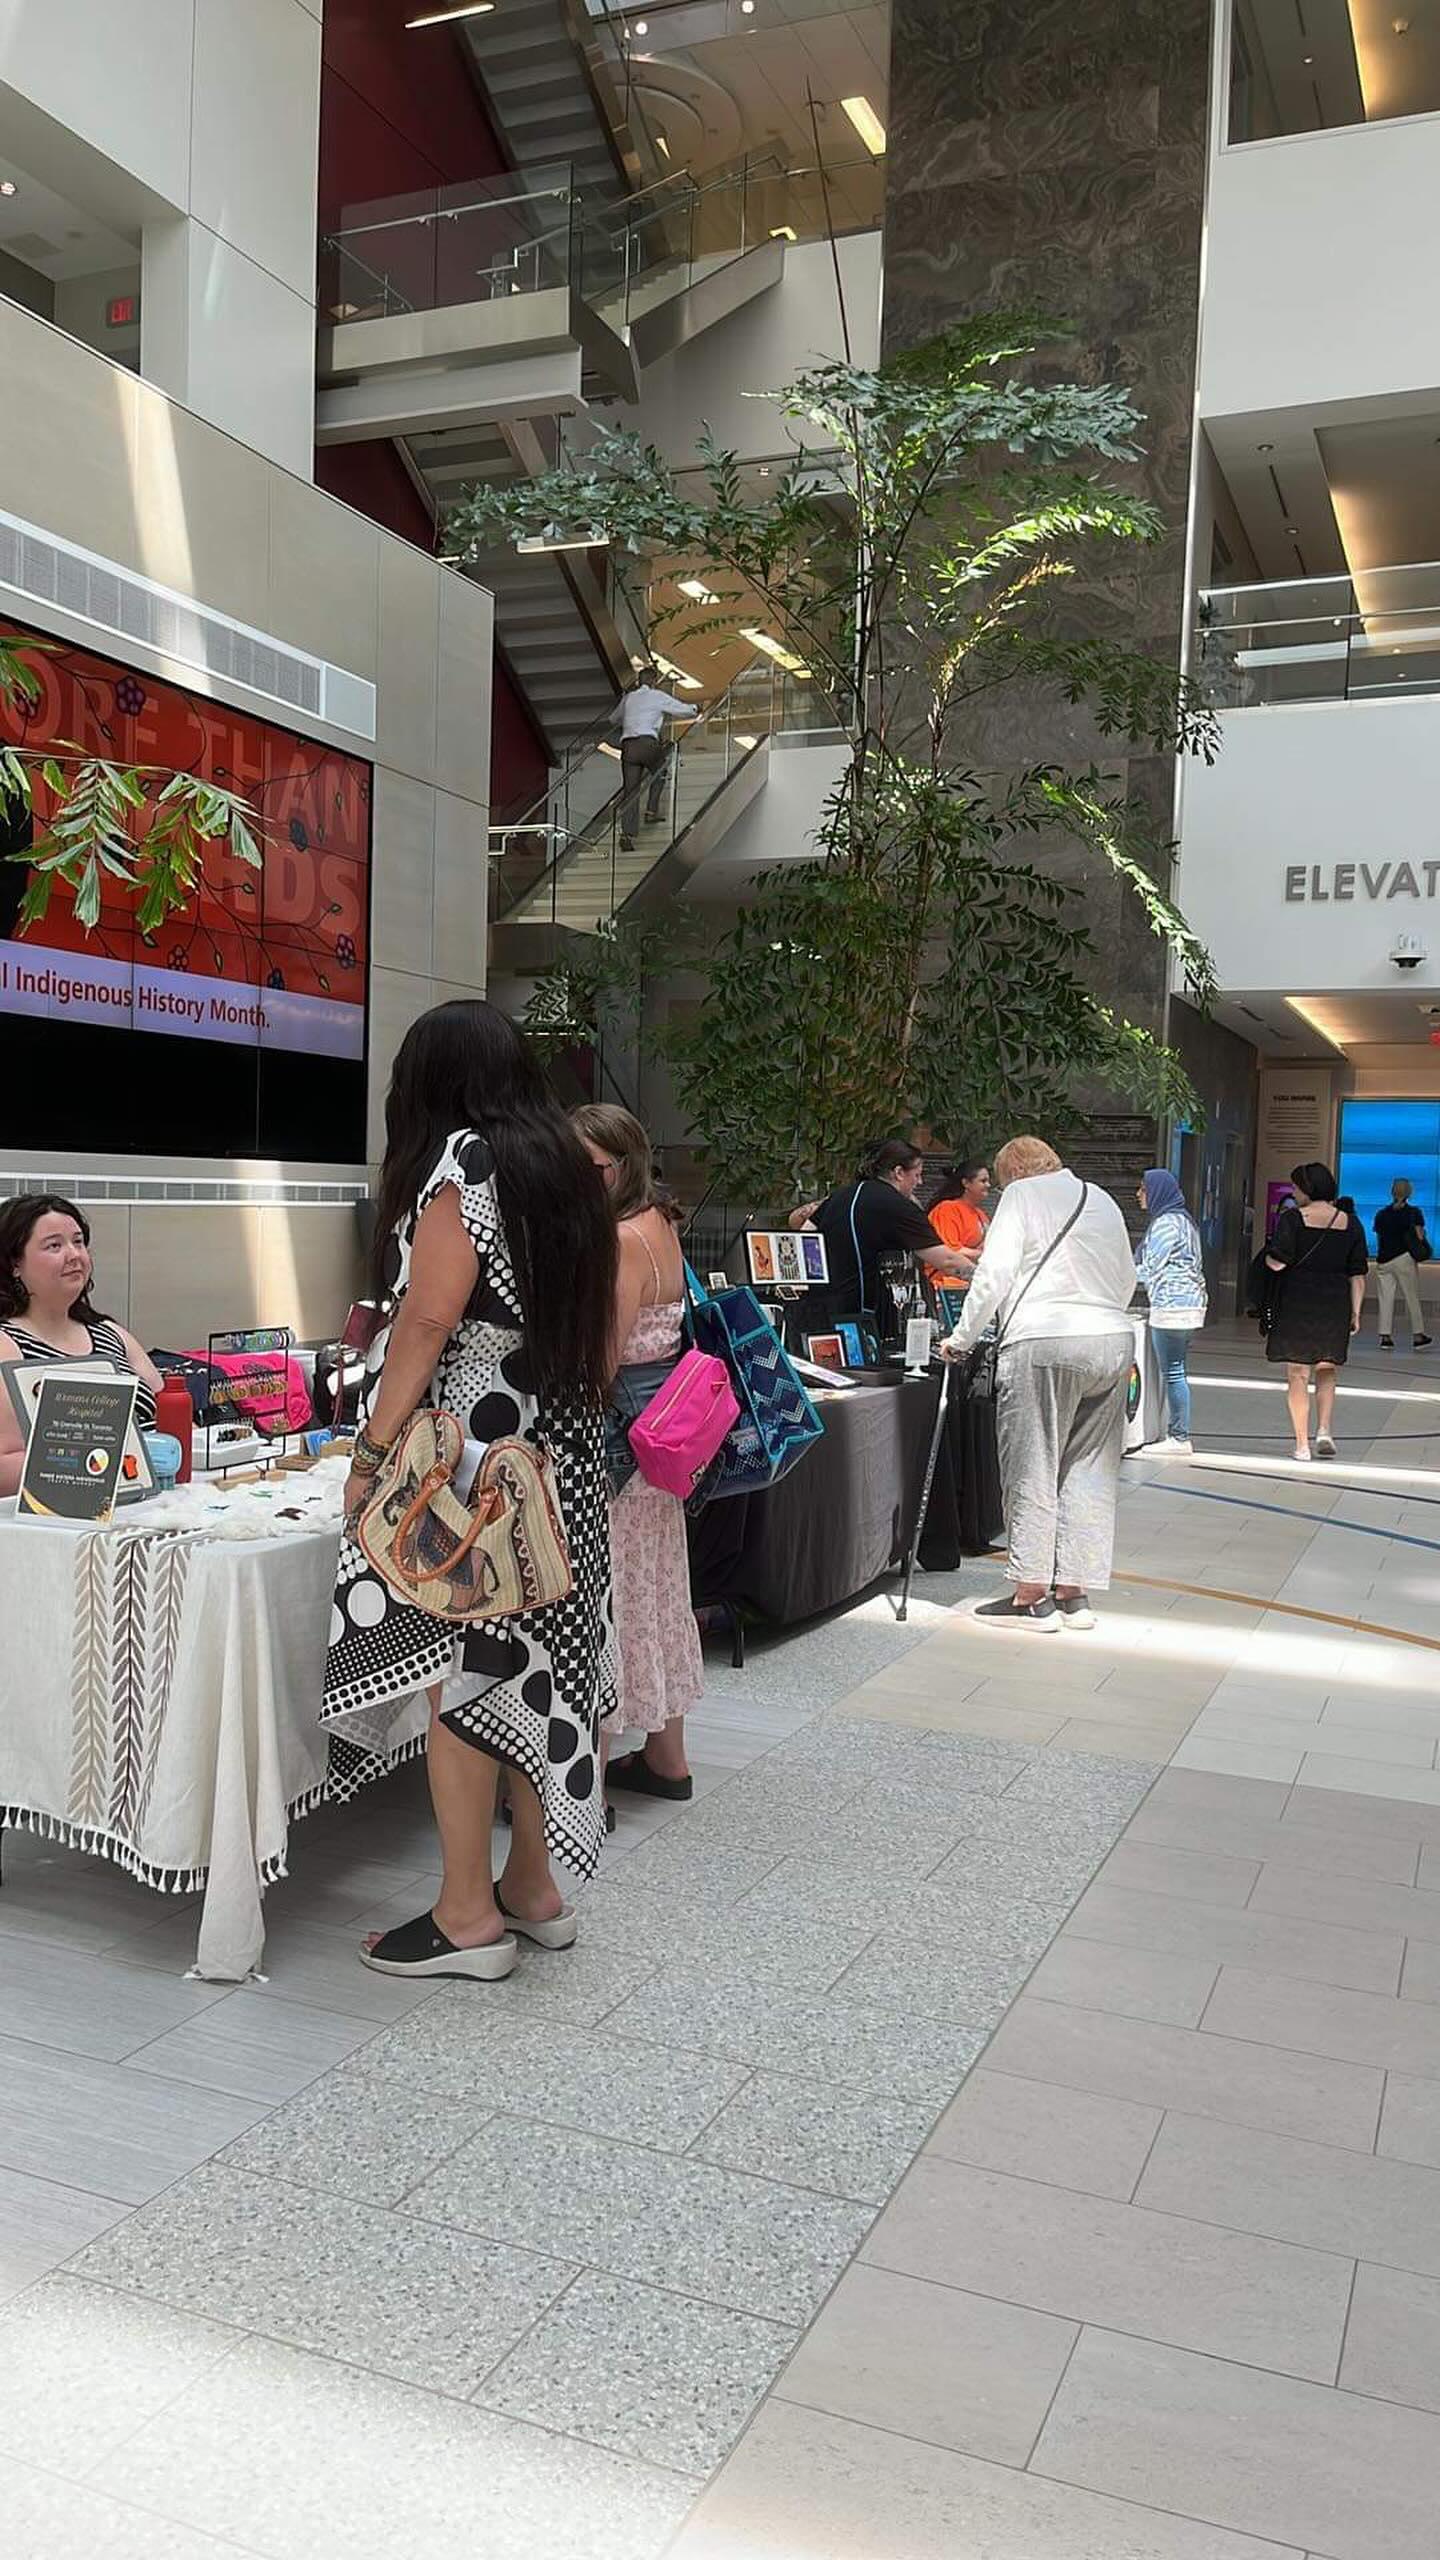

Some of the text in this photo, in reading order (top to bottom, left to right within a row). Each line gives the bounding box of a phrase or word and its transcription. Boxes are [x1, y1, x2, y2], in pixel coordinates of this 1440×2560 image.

[1285, 861, 1440, 901] ELEVAT
[16, 965, 132, 1008] Indigenous
[139, 986, 205, 1024] History
[210, 997, 271, 1029] Month.
